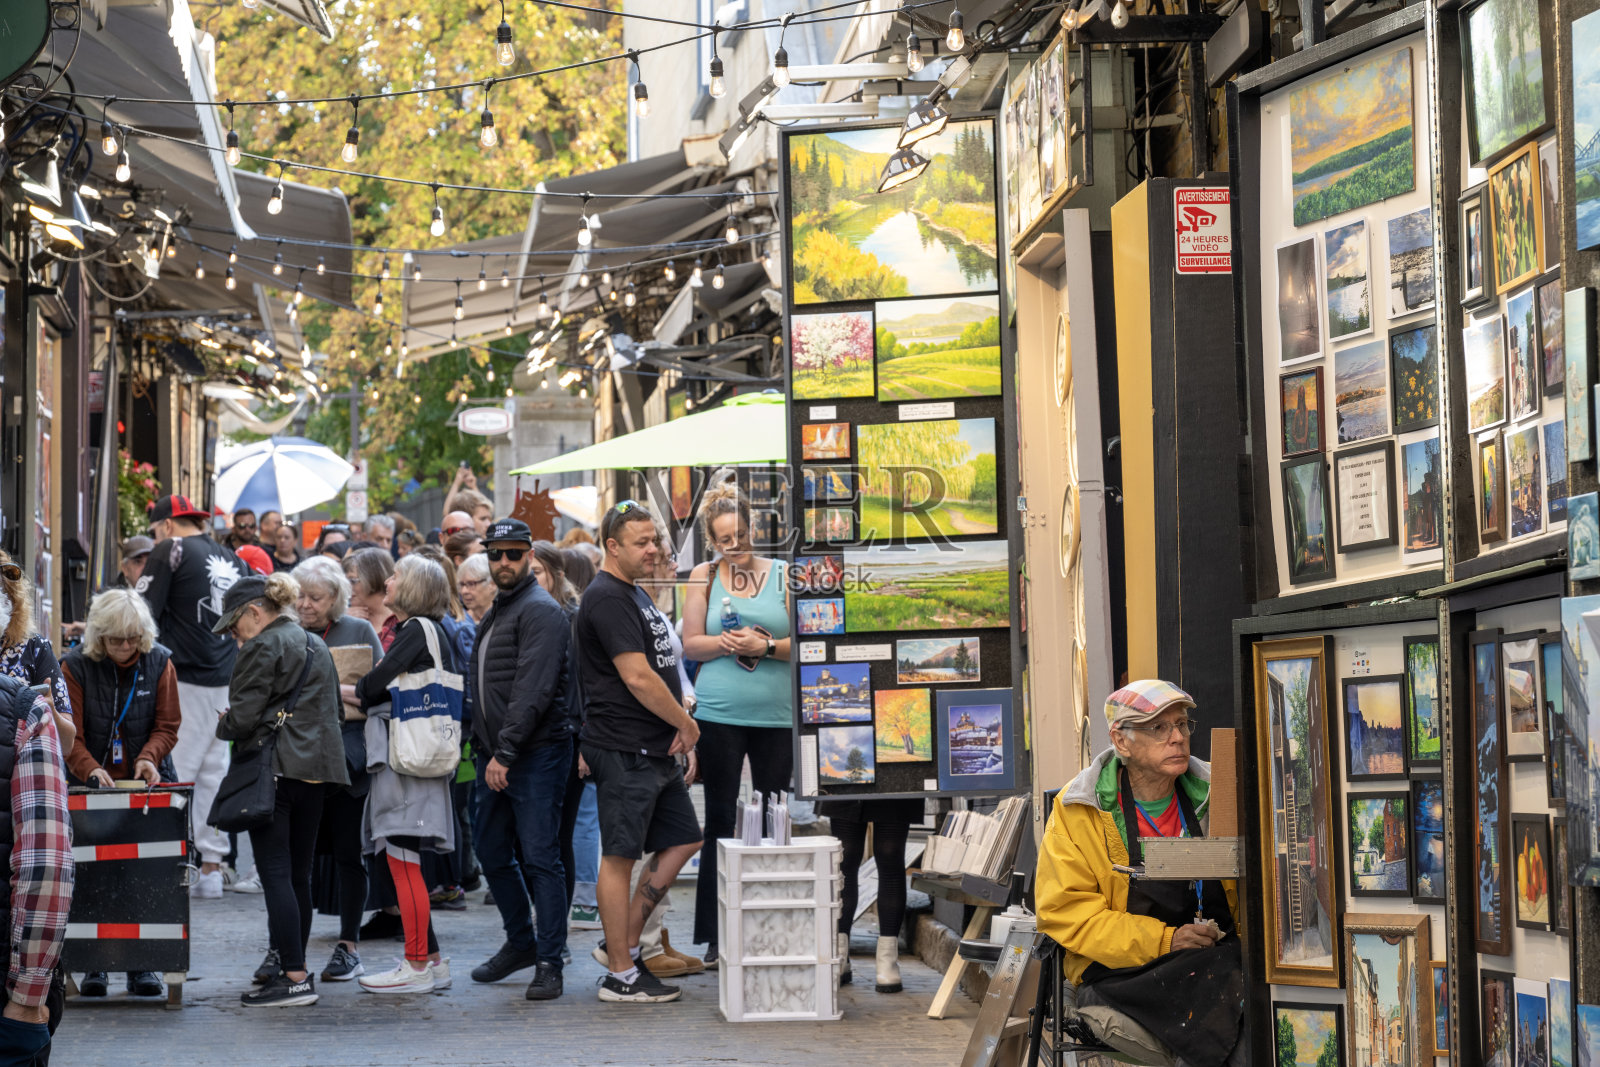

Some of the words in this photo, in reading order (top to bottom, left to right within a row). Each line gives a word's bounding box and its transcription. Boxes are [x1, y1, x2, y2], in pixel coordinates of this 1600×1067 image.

[1179, 191, 1230, 202] AVERTISSEMENT
[1193, 235, 1229, 243] HEURES
[1181, 257, 1231, 266] SURVEILLANCE
[288, 983, 311, 994] HOKA
